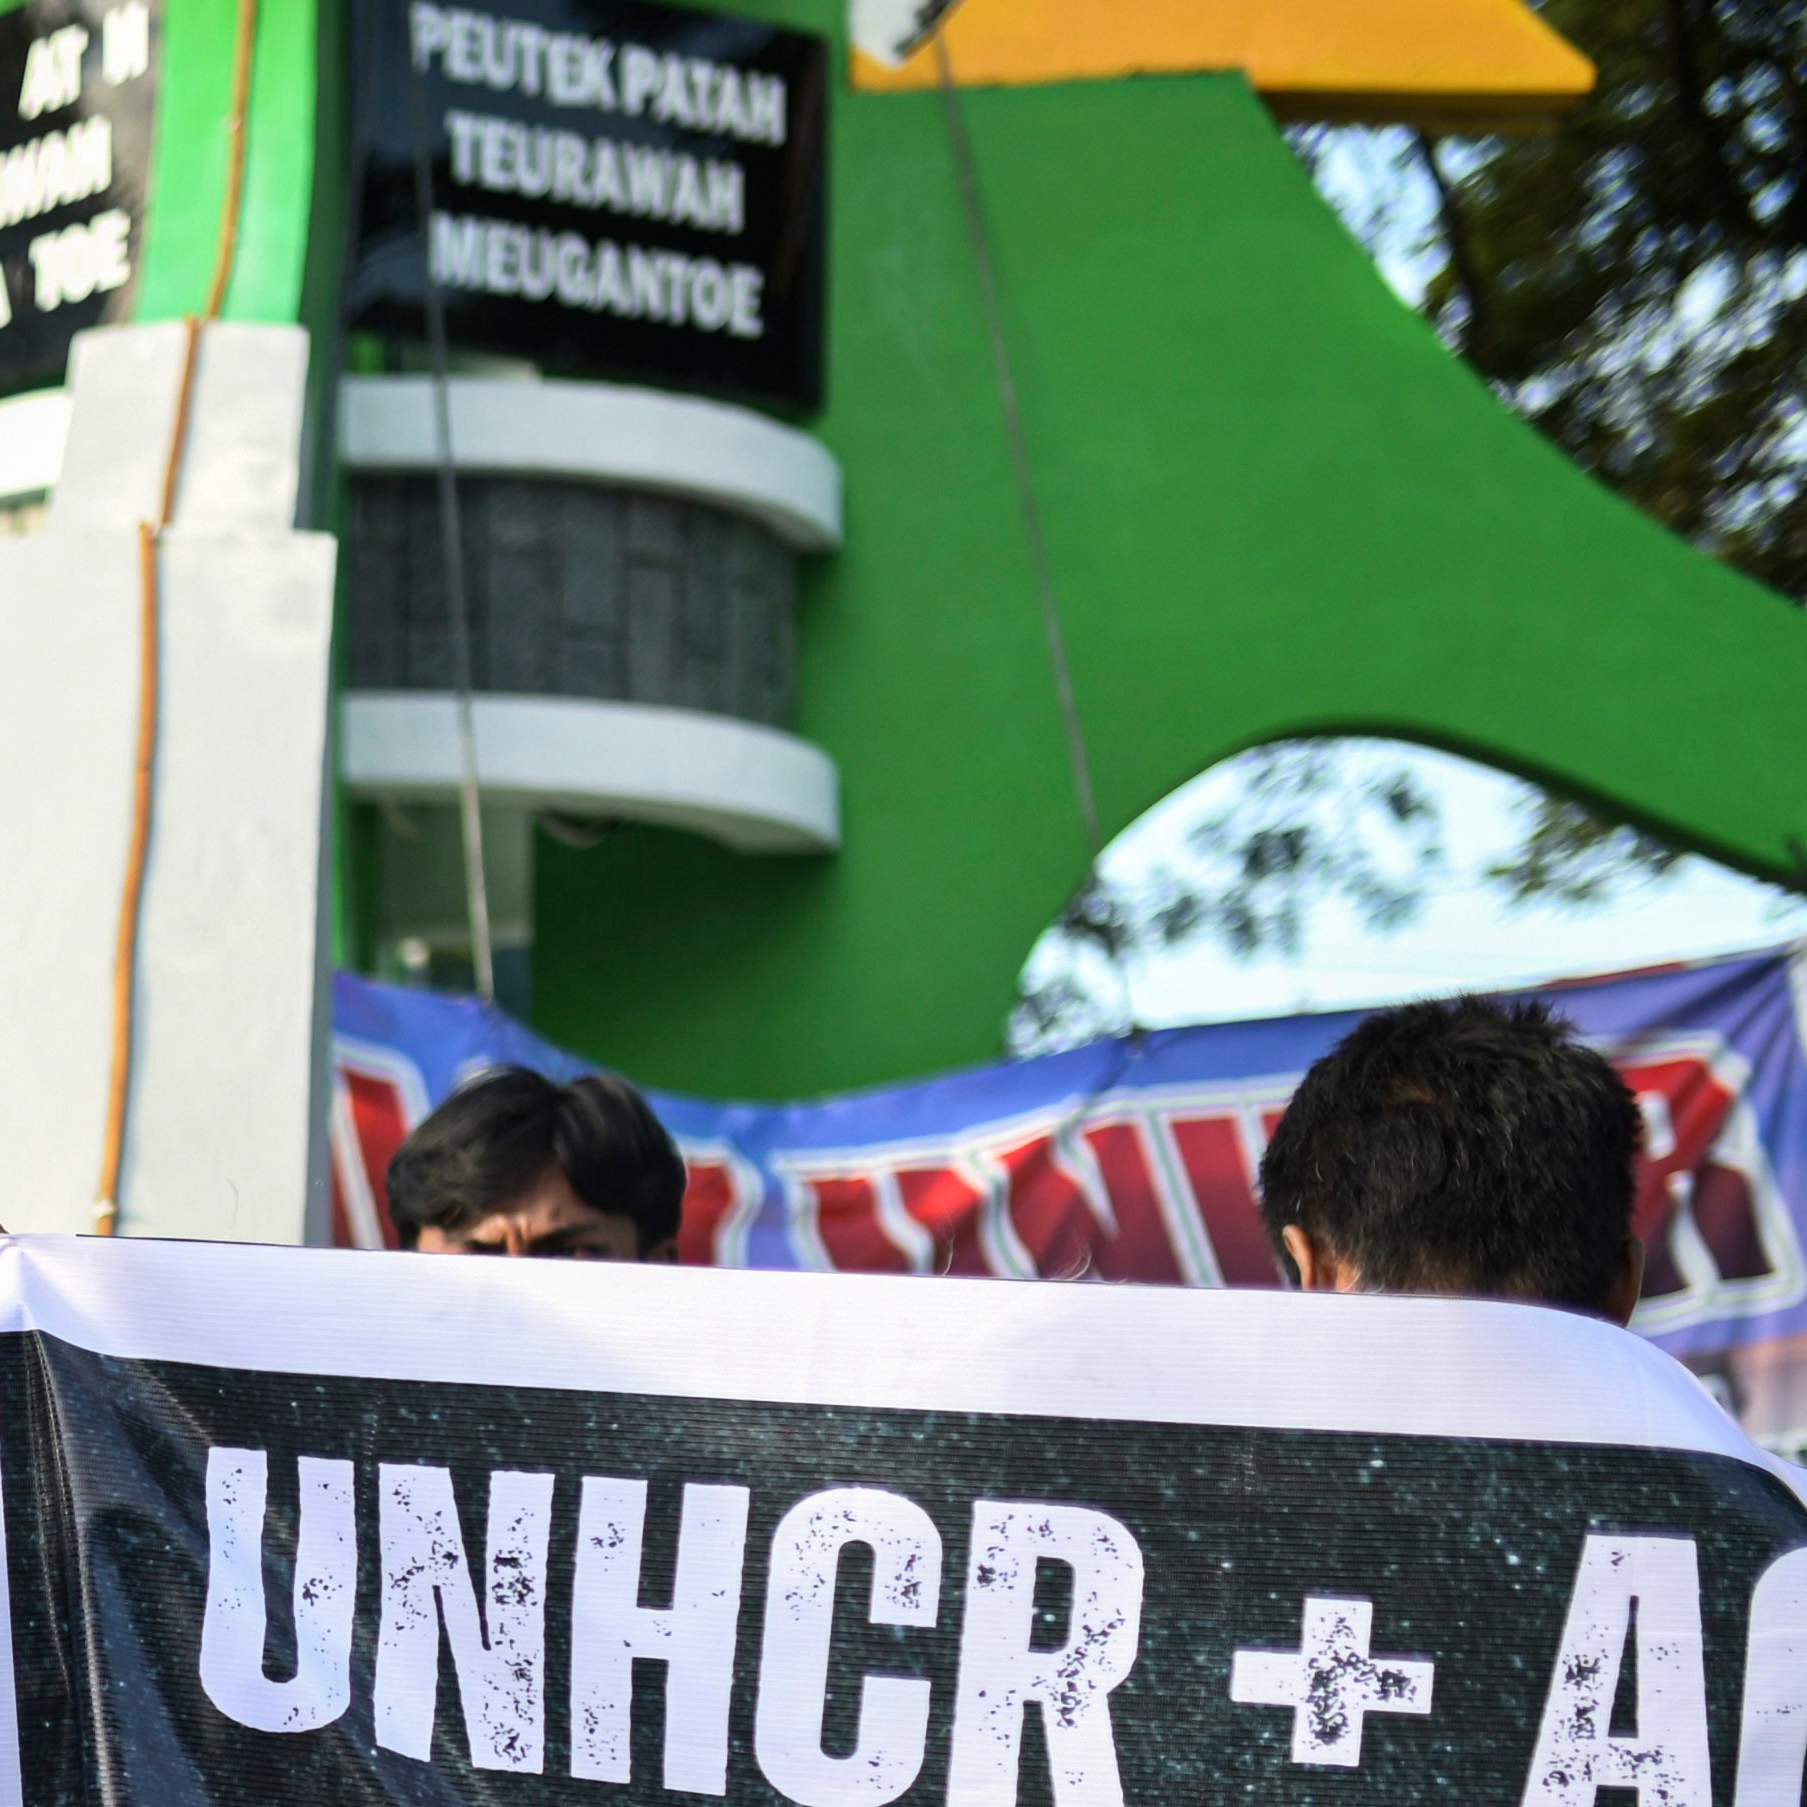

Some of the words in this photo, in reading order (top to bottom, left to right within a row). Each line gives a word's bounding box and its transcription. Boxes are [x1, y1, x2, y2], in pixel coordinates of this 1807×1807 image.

[410, 2, 617, 110] PEUTEK
[620, 43, 786, 147] PATAH
[443, 107, 744, 233] TEURAWAH
[429, 210, 764, 340] MEUGANTOE
